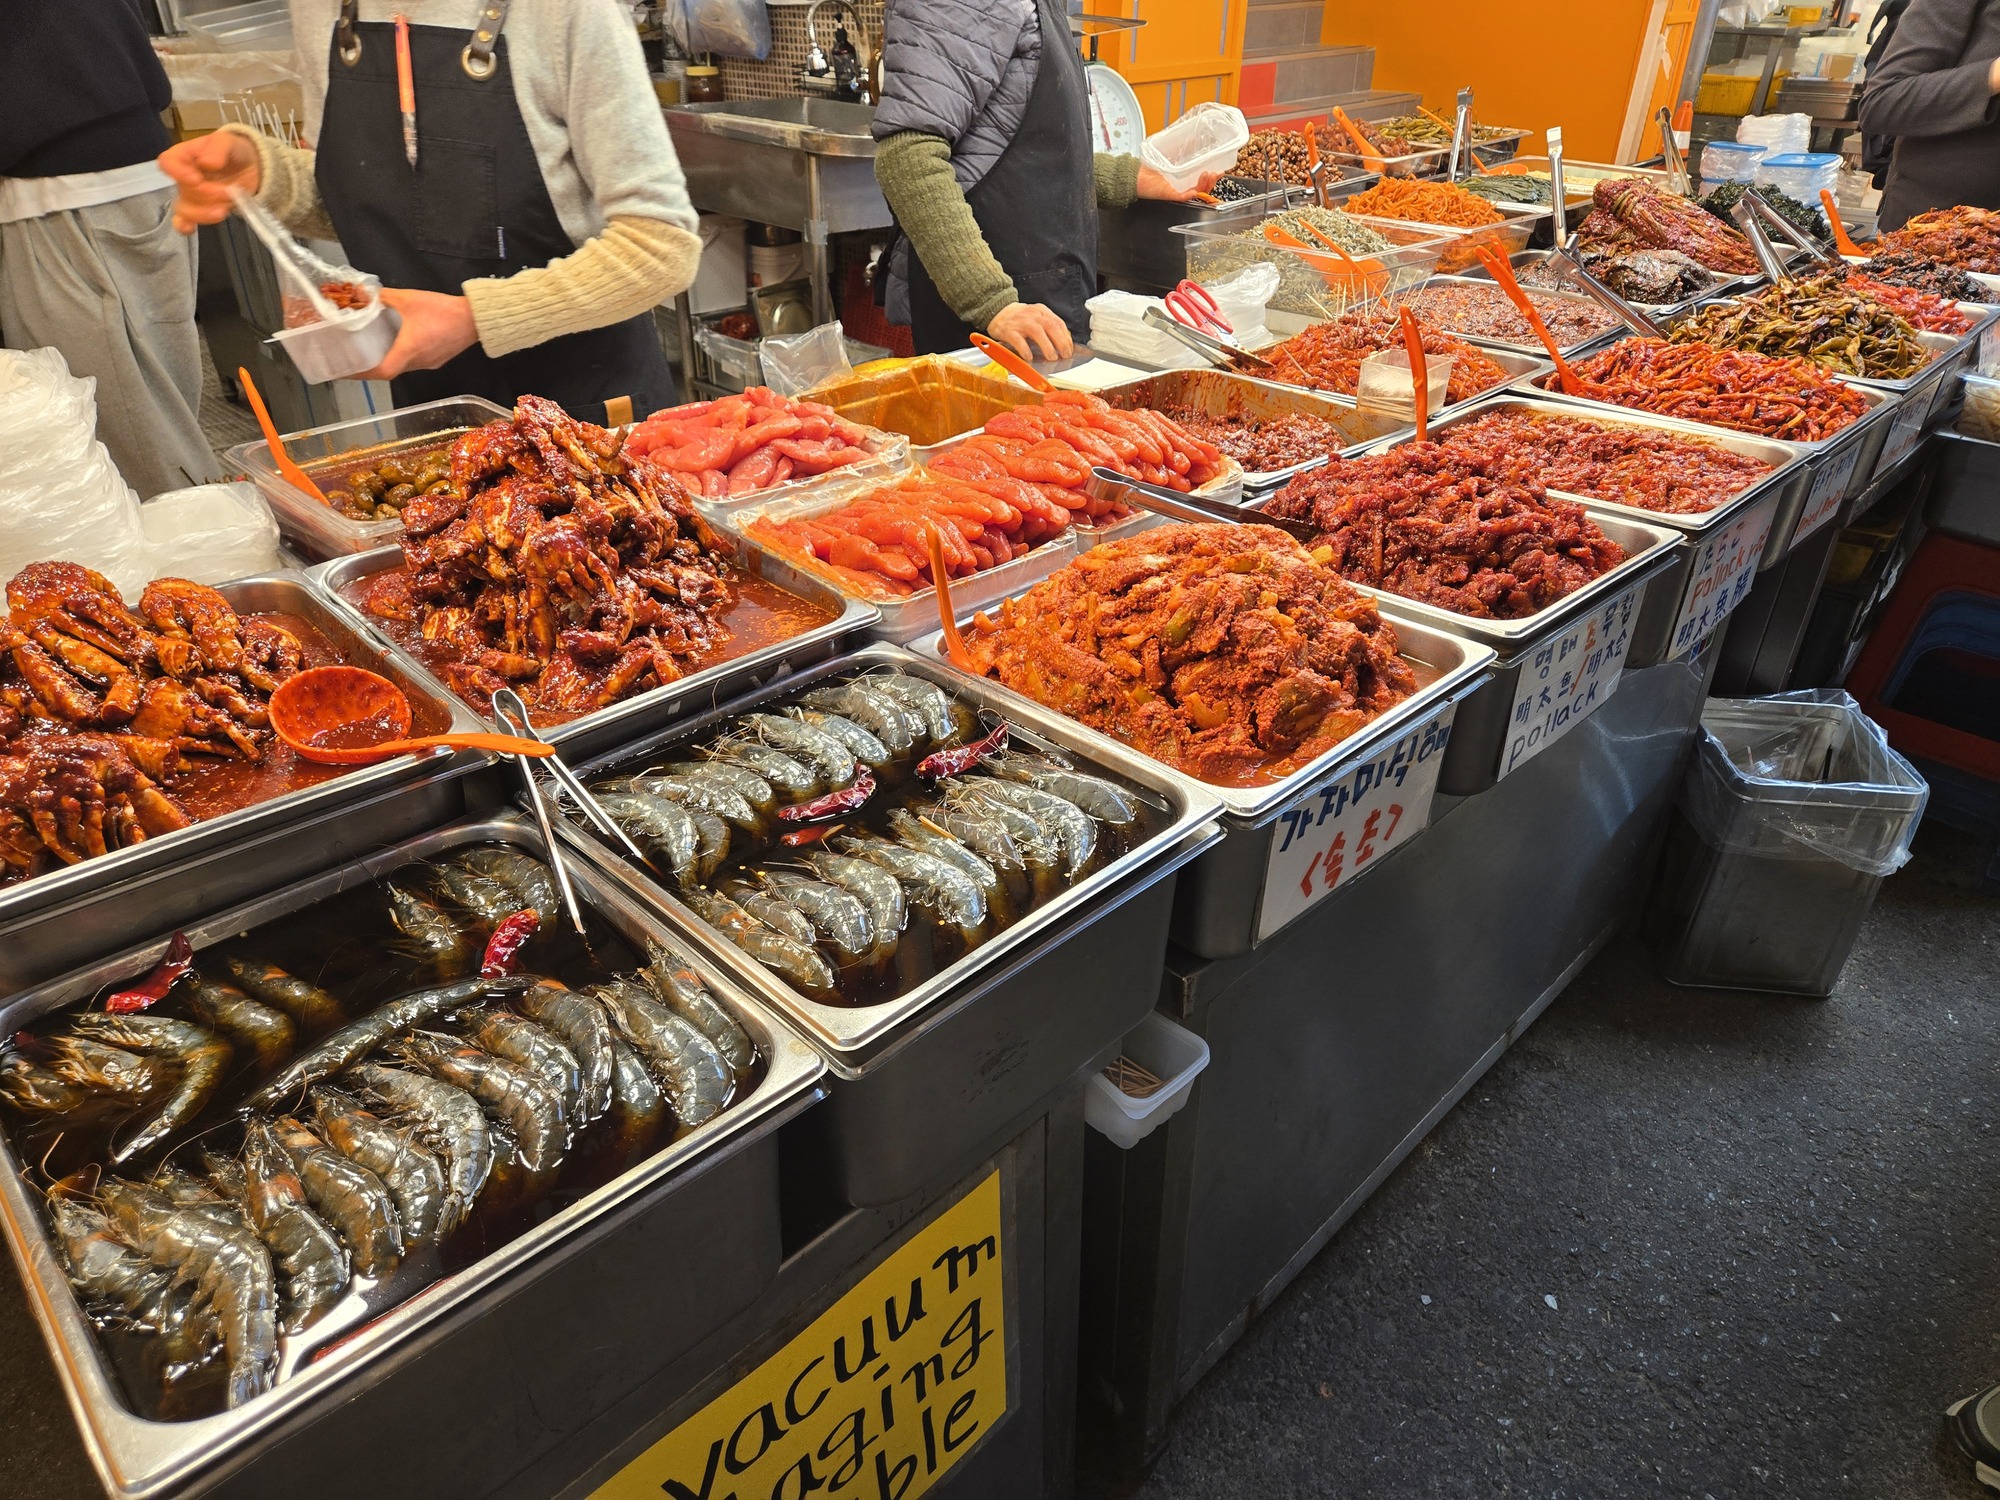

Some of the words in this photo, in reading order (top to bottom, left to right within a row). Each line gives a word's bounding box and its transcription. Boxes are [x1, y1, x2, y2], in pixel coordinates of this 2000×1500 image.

[1698, 520, 1745, 576] たらこ
[1279, 720, 1451, 852] 가자미식해
[661, 1235, 995, 1500] vacuum
[723, 1297, 994, 1500] aging
[850, 1389, 979, 1500] ble
